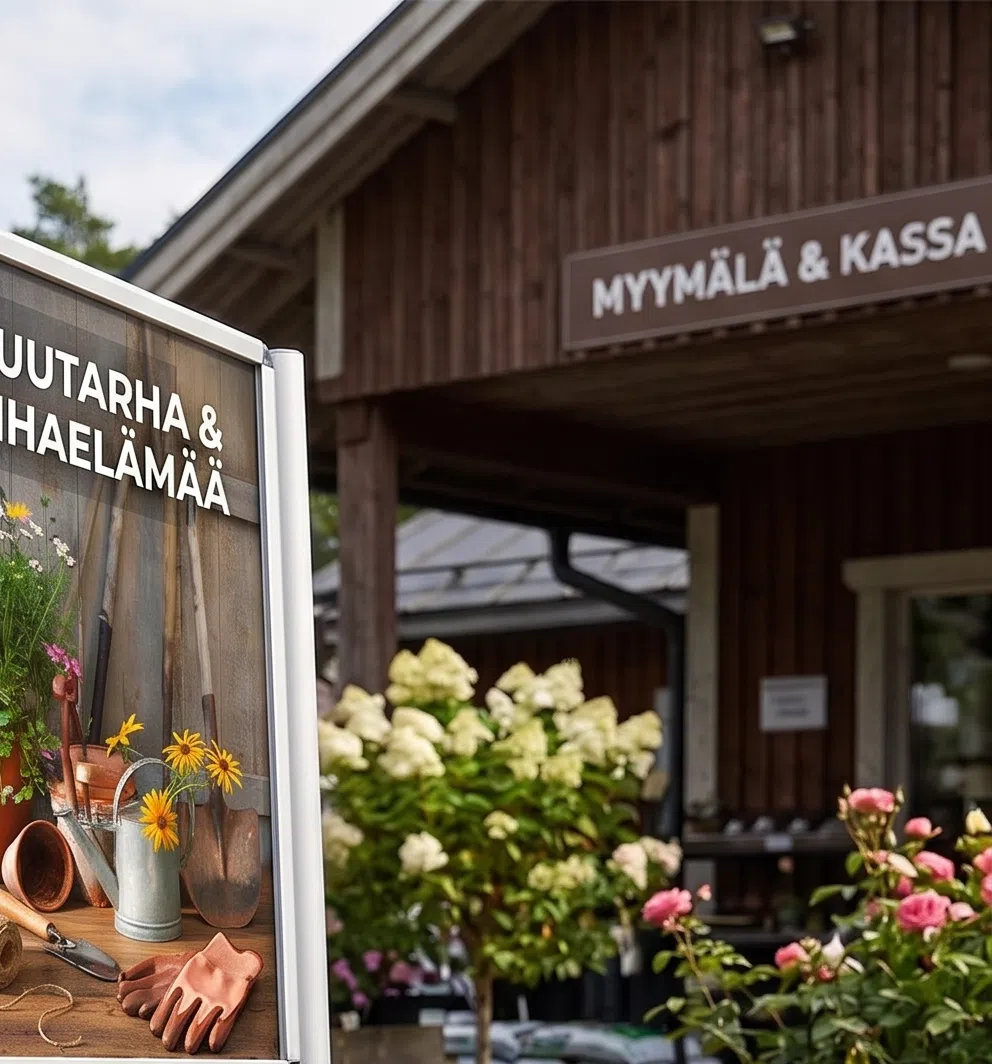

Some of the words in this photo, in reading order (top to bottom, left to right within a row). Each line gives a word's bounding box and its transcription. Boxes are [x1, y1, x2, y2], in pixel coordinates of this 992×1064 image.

[592, 237, 788, 318] MYYMÄLÄ
[797, 240, 830, 283] &
[840, 211, 988, 276] KASSA
[198, 405, 223, 452] &
